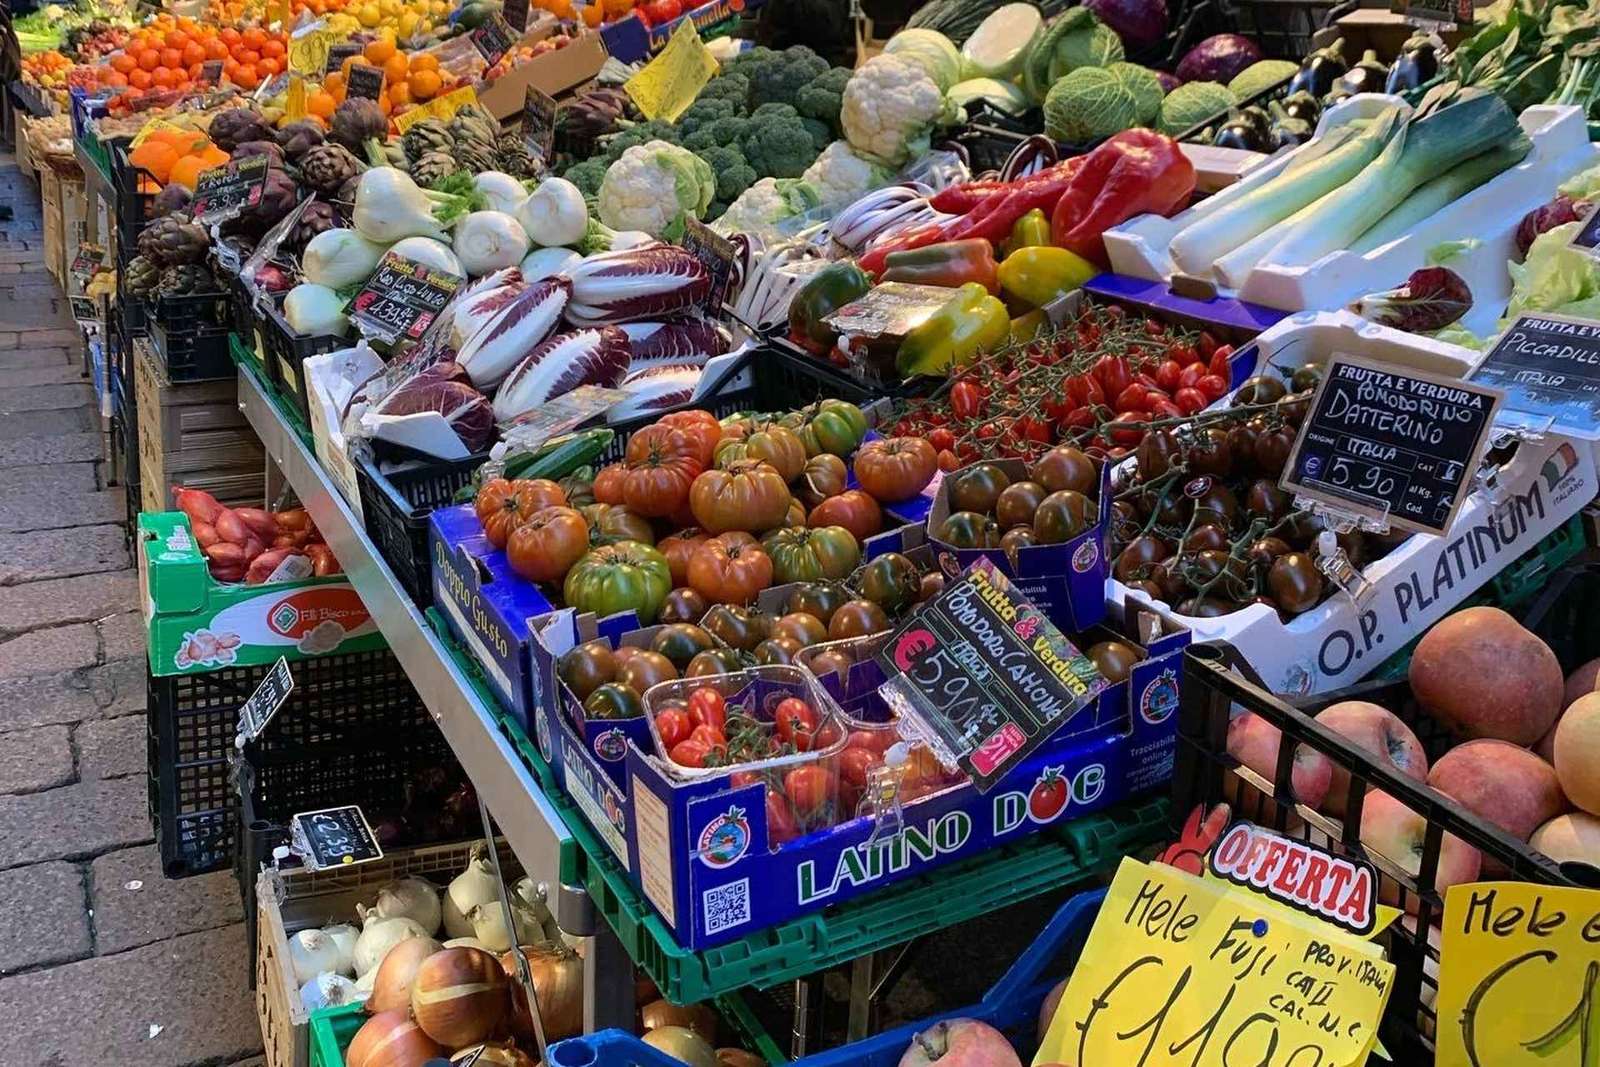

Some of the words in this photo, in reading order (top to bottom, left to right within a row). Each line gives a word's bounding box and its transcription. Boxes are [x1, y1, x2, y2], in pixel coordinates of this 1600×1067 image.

[1502, 332, 1600, 365] PICCADILL
[1522, 319, 1575, 335] FRUTTA
[1577, 325, 1590, 336] E
[1338, 365, 1394, 388] FRUTTA
[1396, 377, 1407, 391] E
[1410, 380, 1482, 409] VERDURA
[1357, 381, 1473, 423] POMODORINO
[1513, 370, 1565, 386] ITALIA
[1325, 388, 1443, 444] DATTERINO
[1348, 437, 1396, 461] ITALIA
[1418, 463, 1434, 472] CAT
[436, 541, 470, 607] Doppio
[472, 595, 508, 658] Gusto
[1318, 608, 1384, 677] O.P.
[1394, 480, 1545, 625] PLATINUM
[895, 629, 936, 672] €
[968, 570, 1017, 621] Frutta
[1032, 636, 1087, 696] Verdura
[797, 810, 972, 906] LATINO
[1214, 824, 1373, 926] OFFERTA
[1124, 879, 1199, 944] Mele
[1464, 889, 1566, 937] Mele
